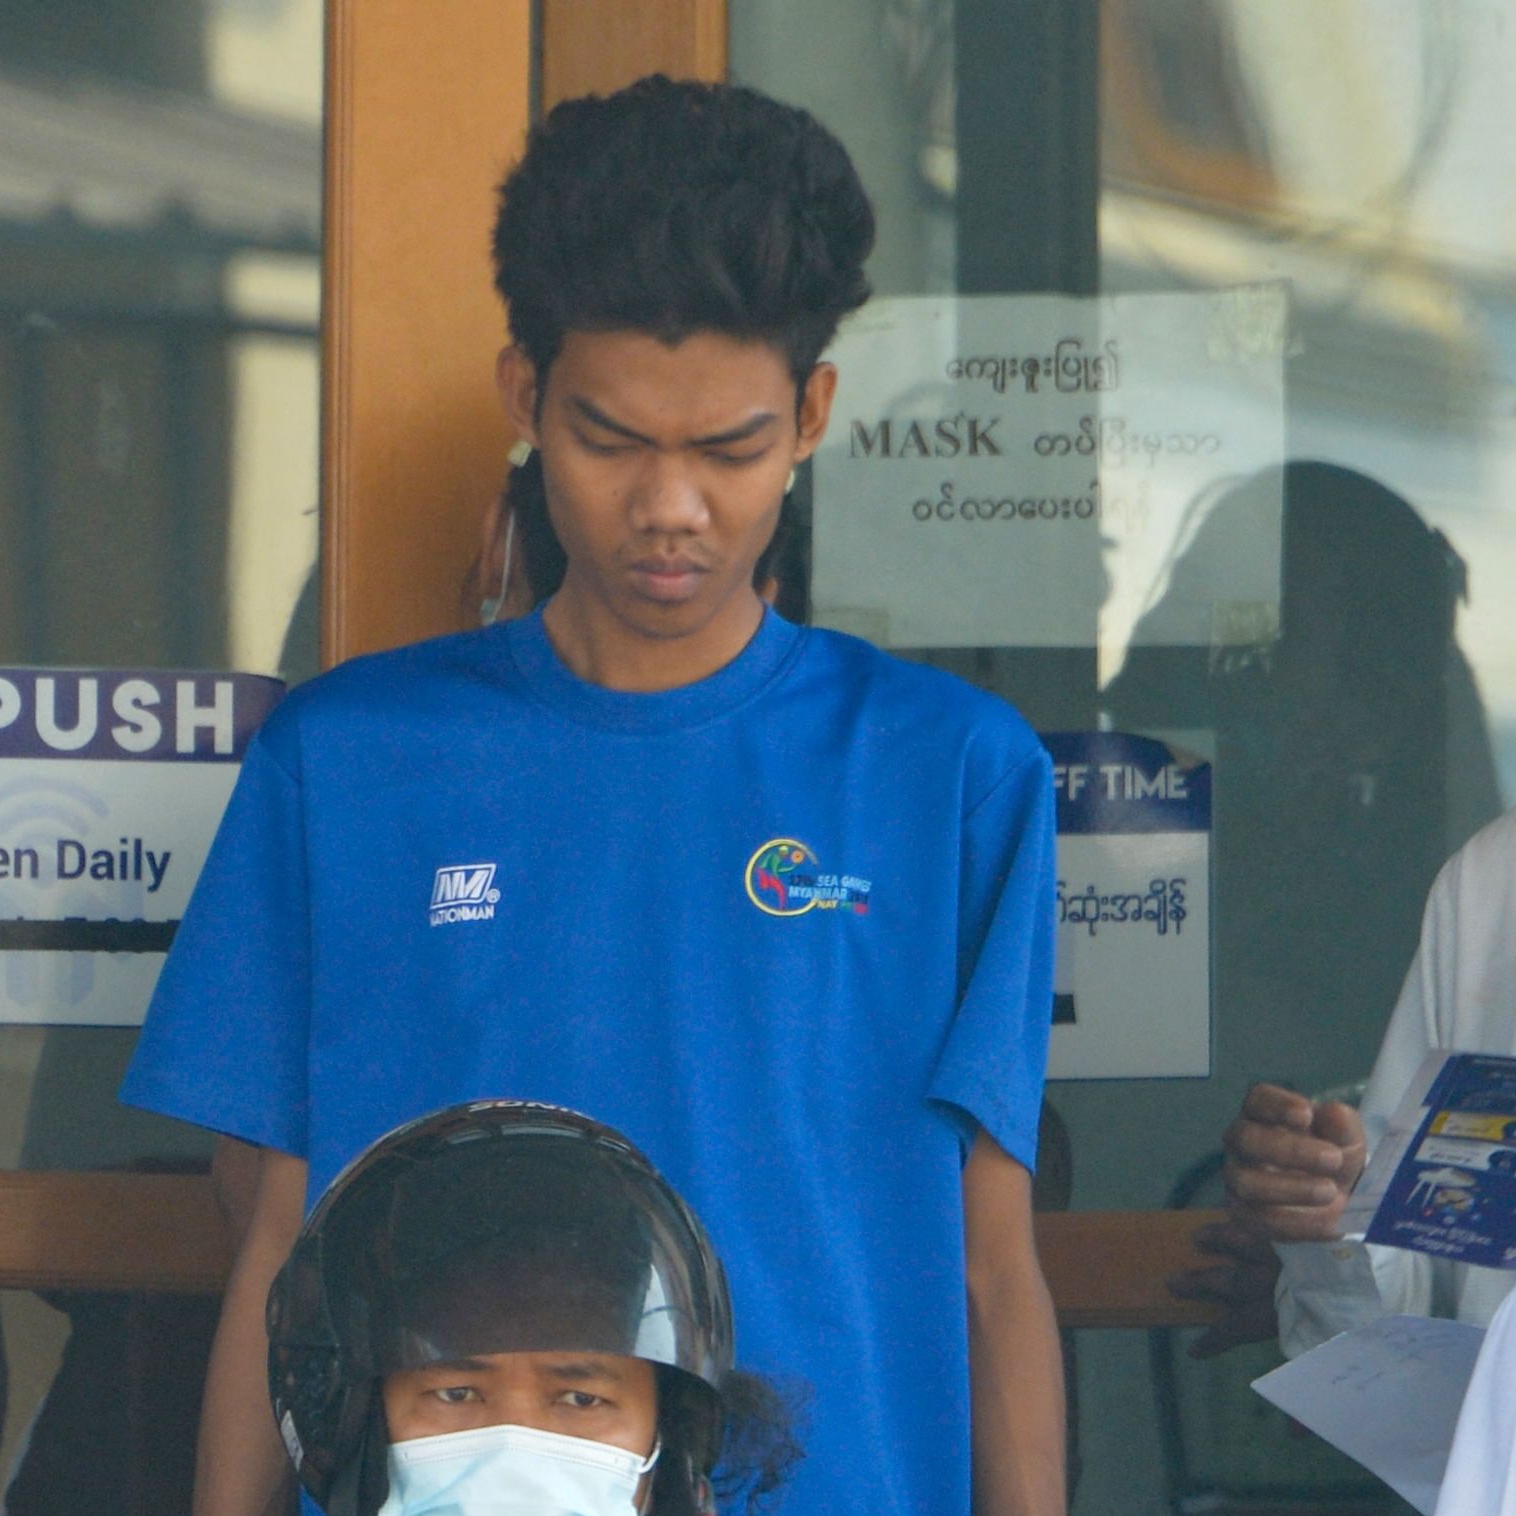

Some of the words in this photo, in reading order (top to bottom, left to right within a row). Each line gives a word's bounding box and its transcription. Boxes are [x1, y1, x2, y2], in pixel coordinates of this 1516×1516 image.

[848, 417, 1005, 460] MASK
[1053, 765, 1089, 801] FF
[1100, 765, 1189, 801] TIME
[56, 837, 172, 892] Daily
[816, 874, 839, 887] SEA
